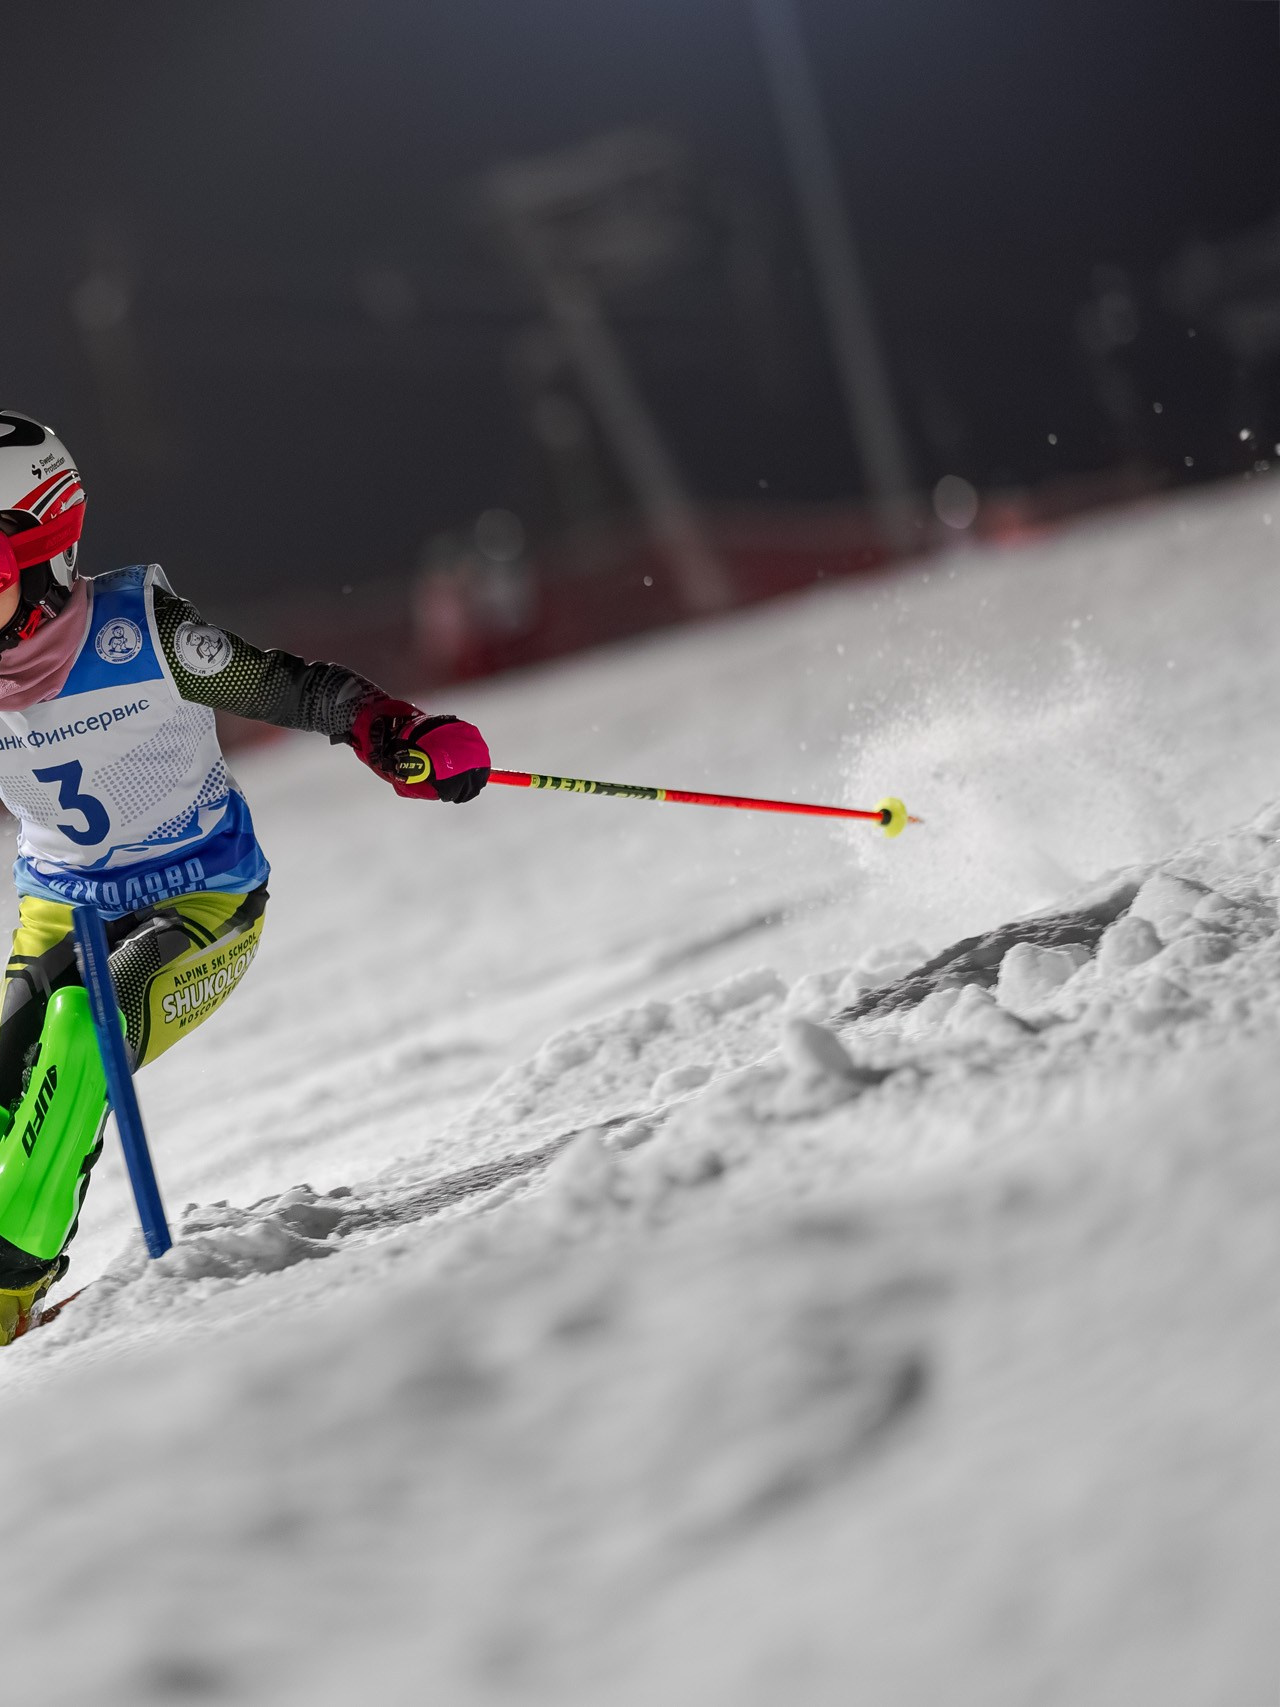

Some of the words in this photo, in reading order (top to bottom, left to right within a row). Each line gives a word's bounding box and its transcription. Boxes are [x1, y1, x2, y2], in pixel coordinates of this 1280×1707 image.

[39, 453, 55, 467] Sweet
[400, 762, 424, 770] LEKI
[543, 776, 597, 794] LEKI
[32, 759, 111, 846] 3
[174, 963, 208, 987] ALPINE
[212, 955, 225, 972] SKI
[228, 932, 256, 960] SCHOOL
[179, 997, 219, 1029] MOSCOW
[22, 1076, 56, 1158] UFO
